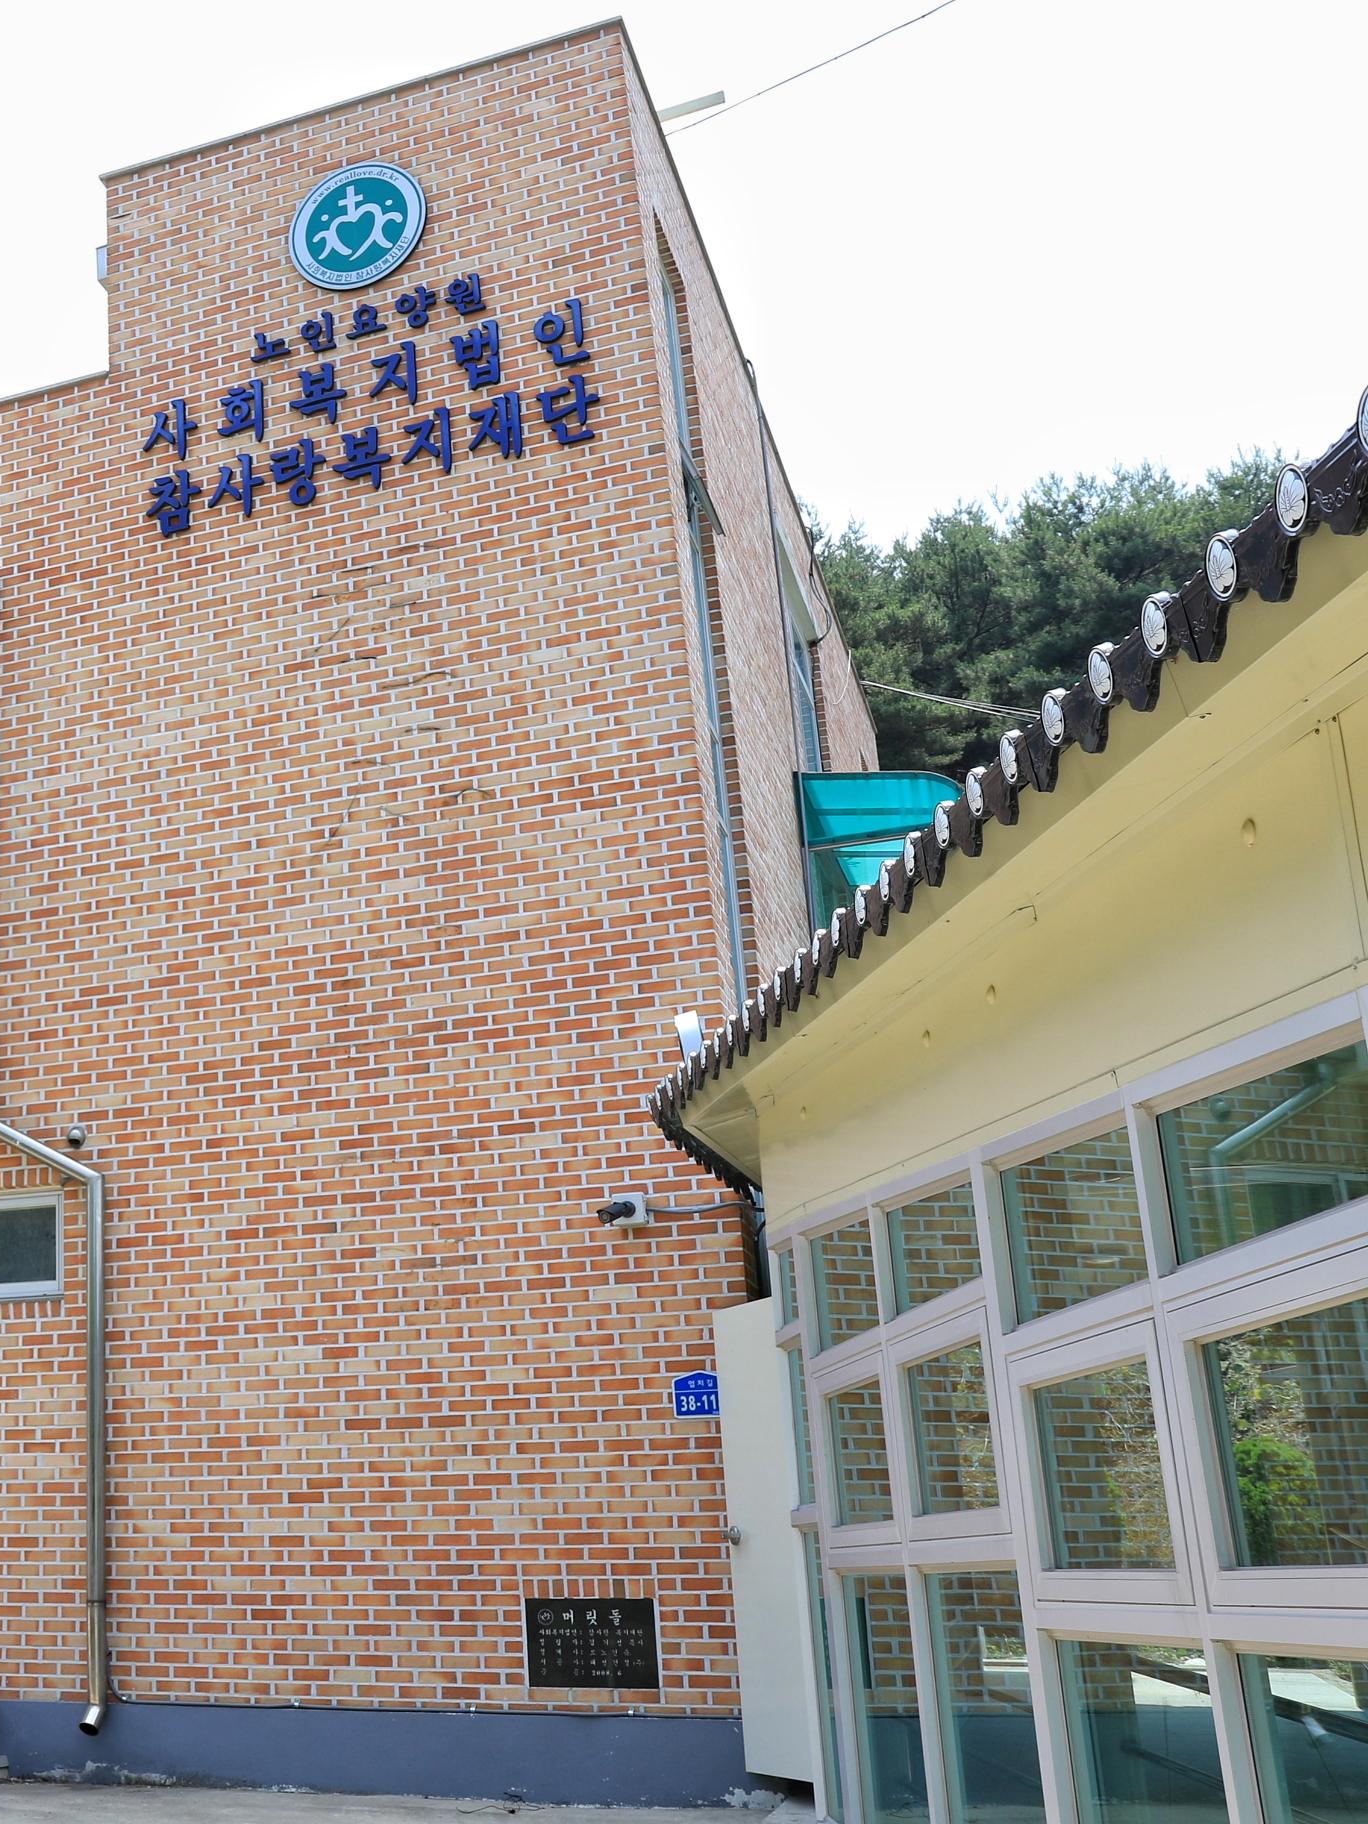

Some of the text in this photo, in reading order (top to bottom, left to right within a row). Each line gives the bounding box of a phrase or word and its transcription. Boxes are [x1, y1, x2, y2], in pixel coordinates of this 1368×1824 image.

[306, 236, 410, 282] 사회복지법인 참사랑복지재단
[250, 272, 487, 364] 노인요양원
[143, 297, 591, 461] 사회복지법인
[145, 374, 600, 537] 참사랑복지재단
[680, 1394, 716, 1411] 38-11
[562, 1608, 622, 1626] 머릿돌
